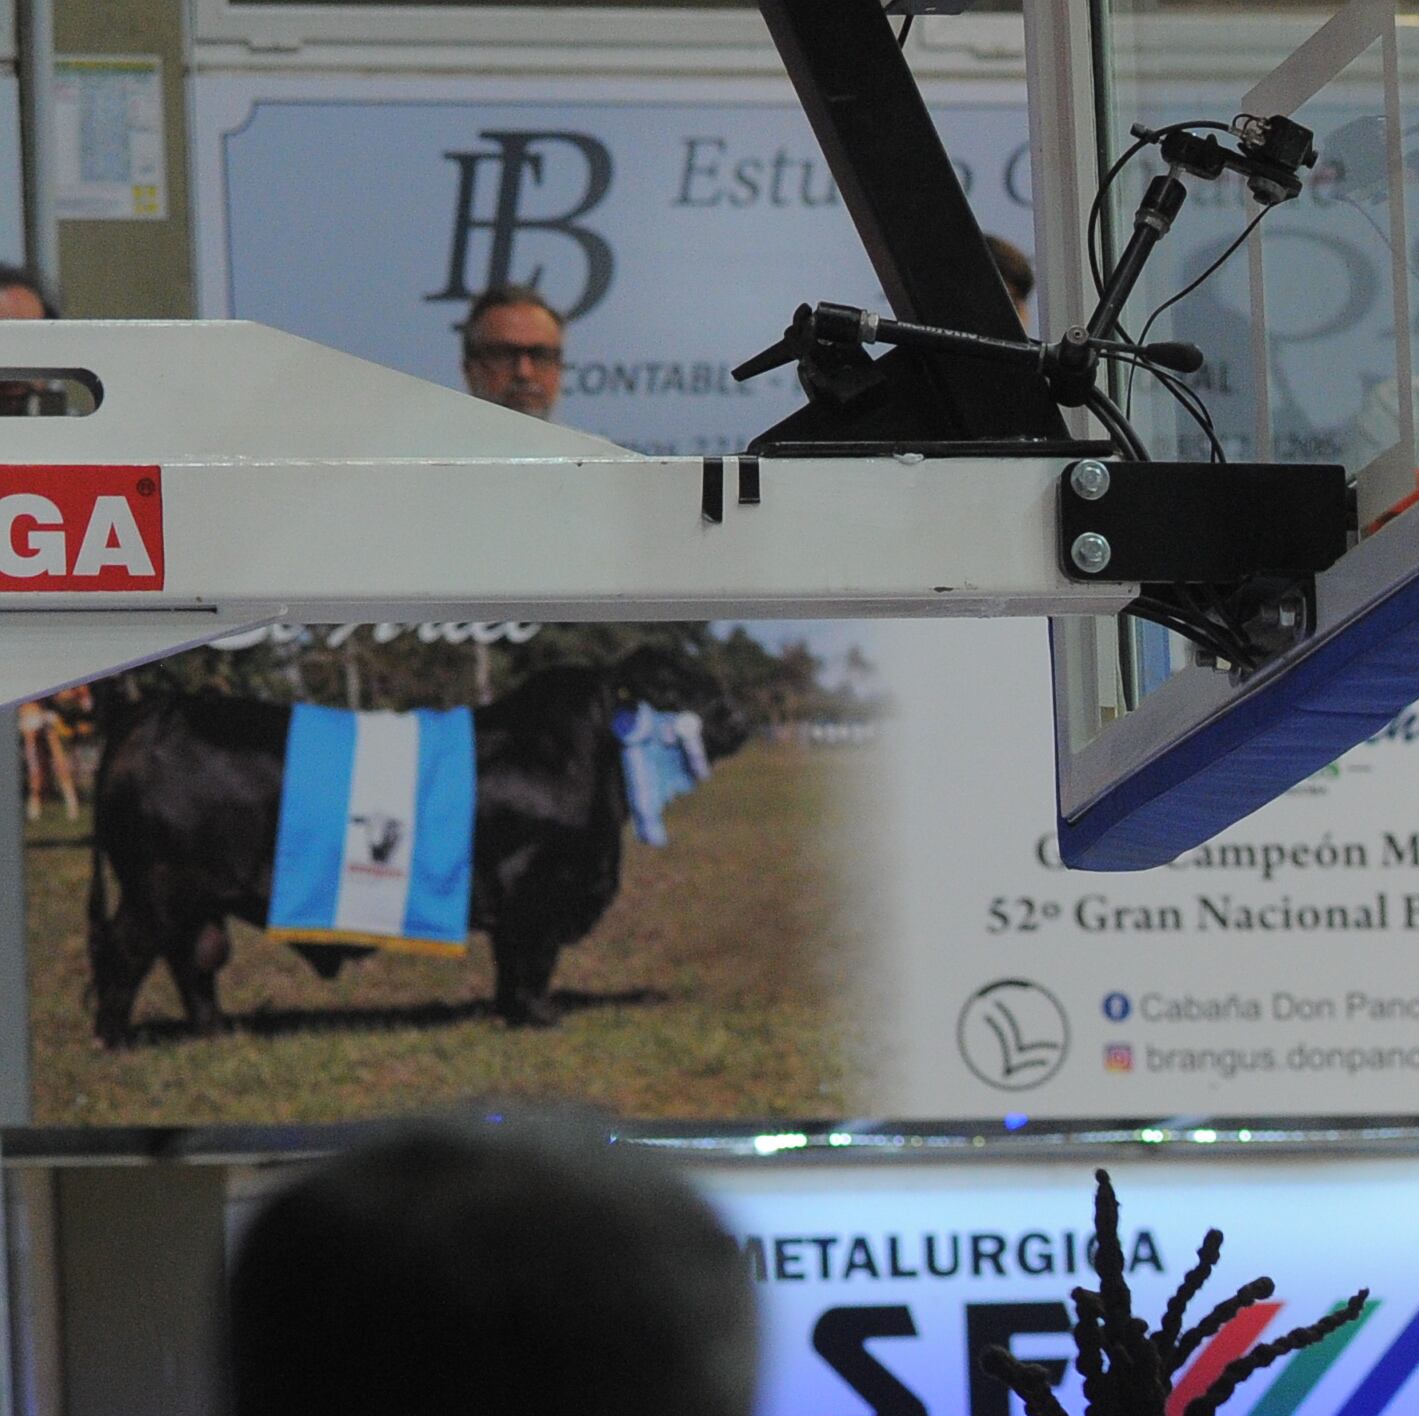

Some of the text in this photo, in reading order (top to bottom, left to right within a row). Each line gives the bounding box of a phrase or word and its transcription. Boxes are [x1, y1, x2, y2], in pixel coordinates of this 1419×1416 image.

[1075, 897, 1184, 932] Gran
[1200, 894, 1390, 932] Nacional
[1272, 991, 1336, 1022] Don
